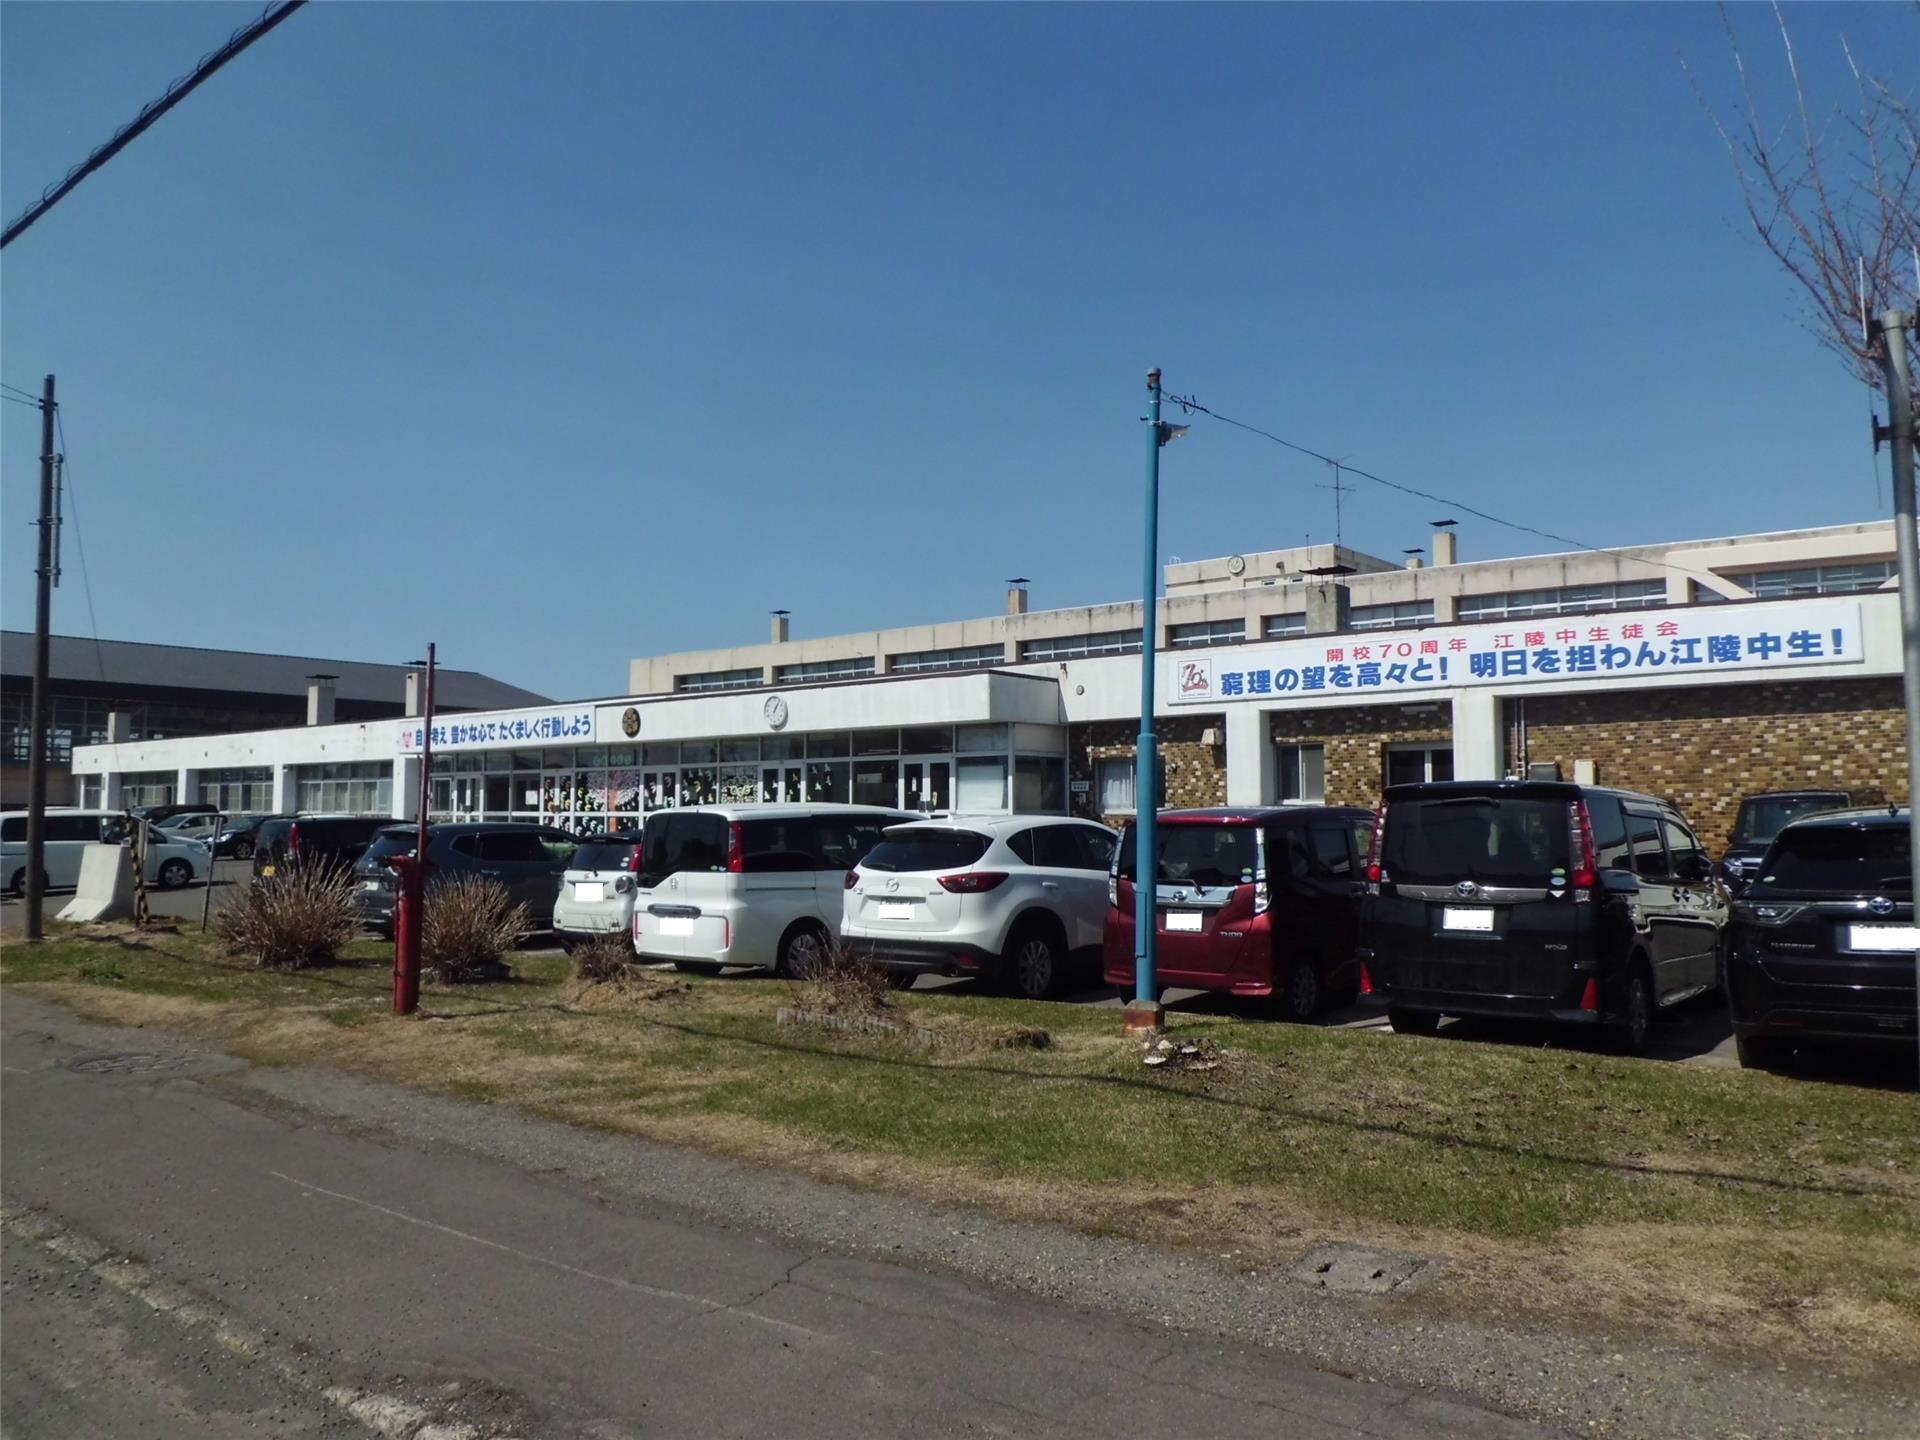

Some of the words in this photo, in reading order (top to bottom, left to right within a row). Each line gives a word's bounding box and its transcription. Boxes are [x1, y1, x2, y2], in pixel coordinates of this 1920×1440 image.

[1327, 637, 1468, 663] 開校70周年
[1494, 621, 1679, 649] 江陵中生徒会
[415, 726, 448, 747] 自考え
[451, 723, 496, 743] 豊かな心で
[499, 714, 592, 741] たくましく行動しよう
